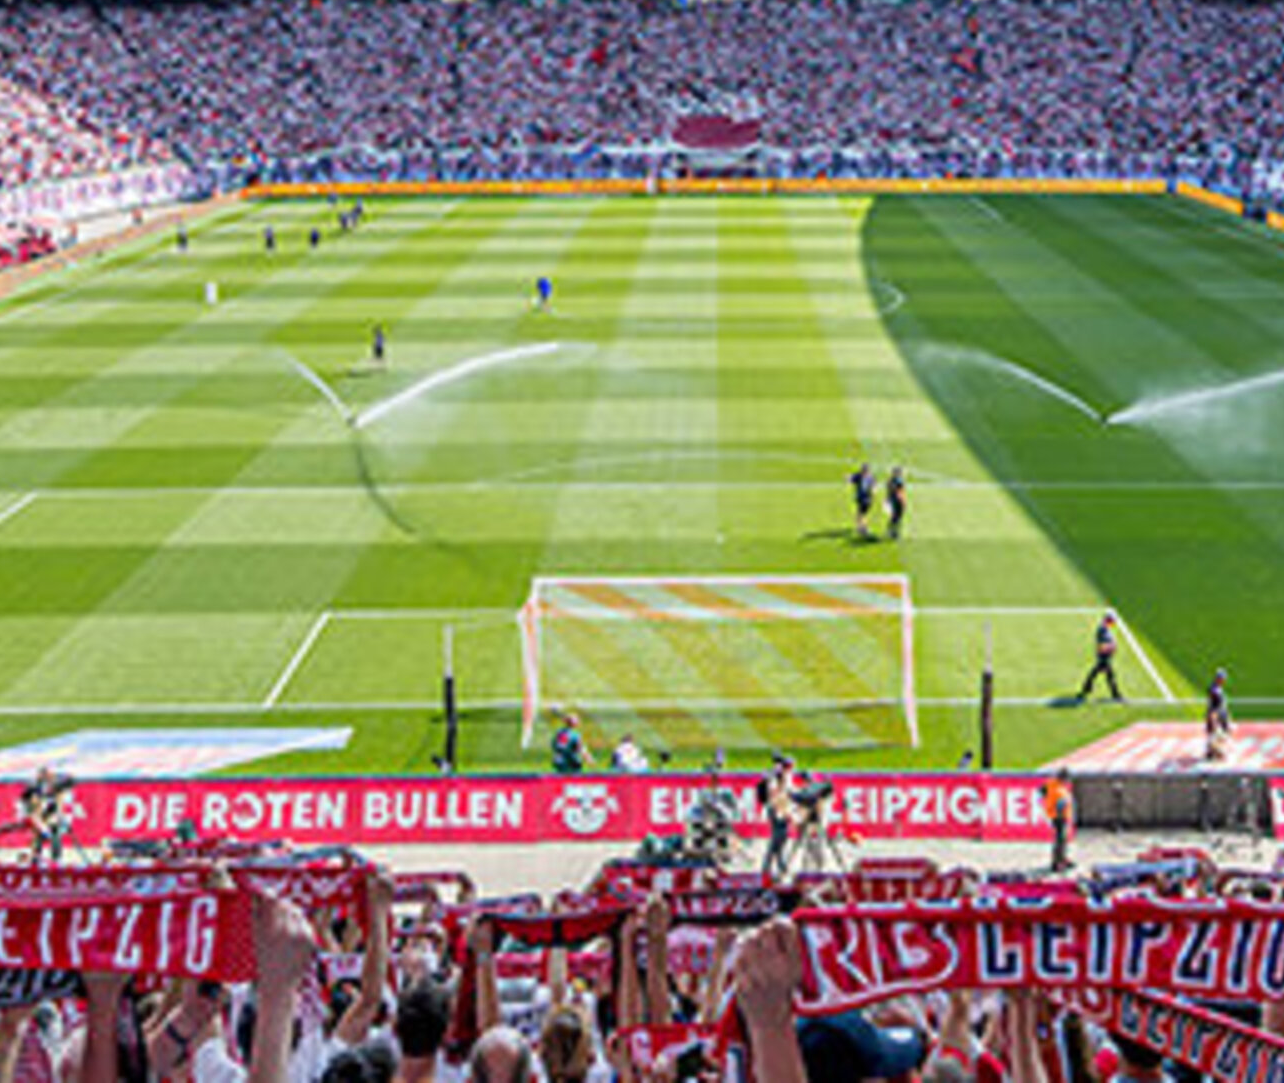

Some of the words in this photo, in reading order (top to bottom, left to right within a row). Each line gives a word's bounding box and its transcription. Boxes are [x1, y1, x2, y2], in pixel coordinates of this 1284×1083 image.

[113, 793, 187, 829] DIE
[201, 792, 348, 830] ROTEN
[364, 791, 523, 829] BULLEN
[797, 917, 960, 1009] RB
